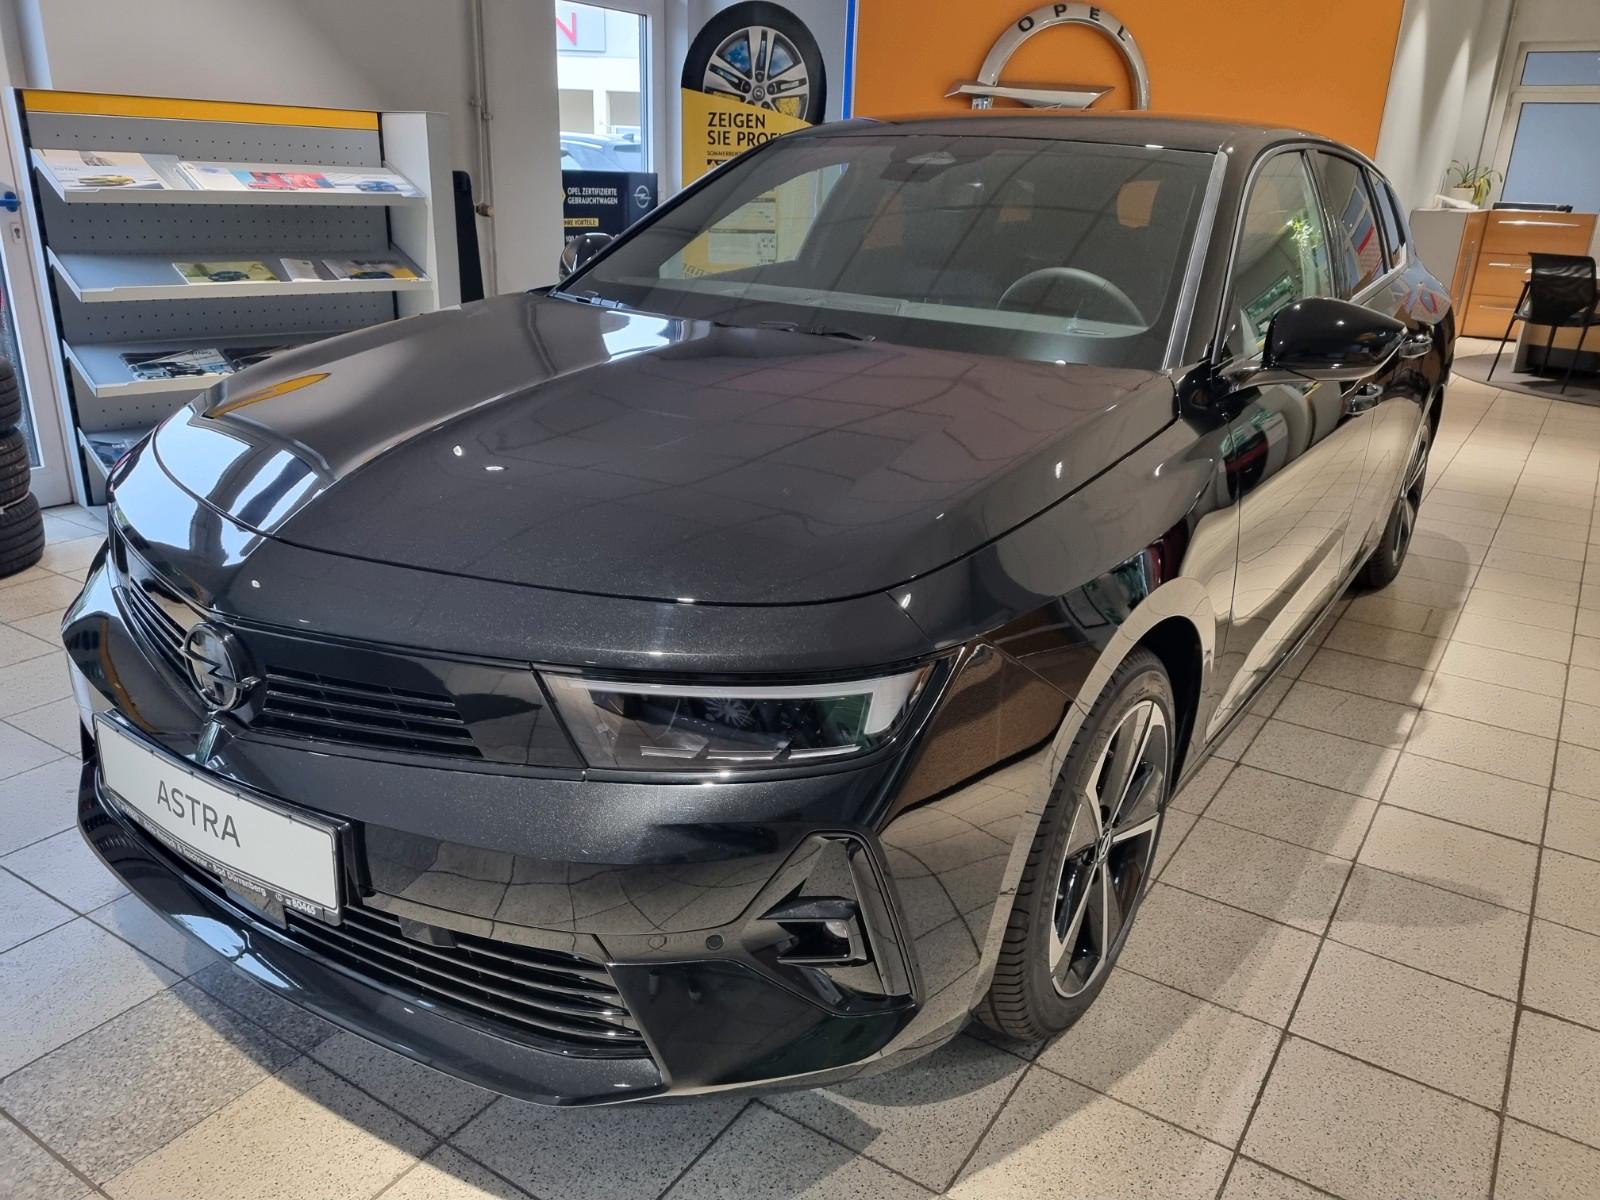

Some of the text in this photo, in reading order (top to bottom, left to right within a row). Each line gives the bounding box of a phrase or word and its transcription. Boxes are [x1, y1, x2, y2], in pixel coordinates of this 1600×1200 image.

[1018, 4, 1126, 42] OPEL
[707, 112, 766, 129] ZEIGEN
[707, 130, 732, 146] SIE
[567, 187, 581, 195] OPEL
[157, 779, 241, 848] ASTRA
